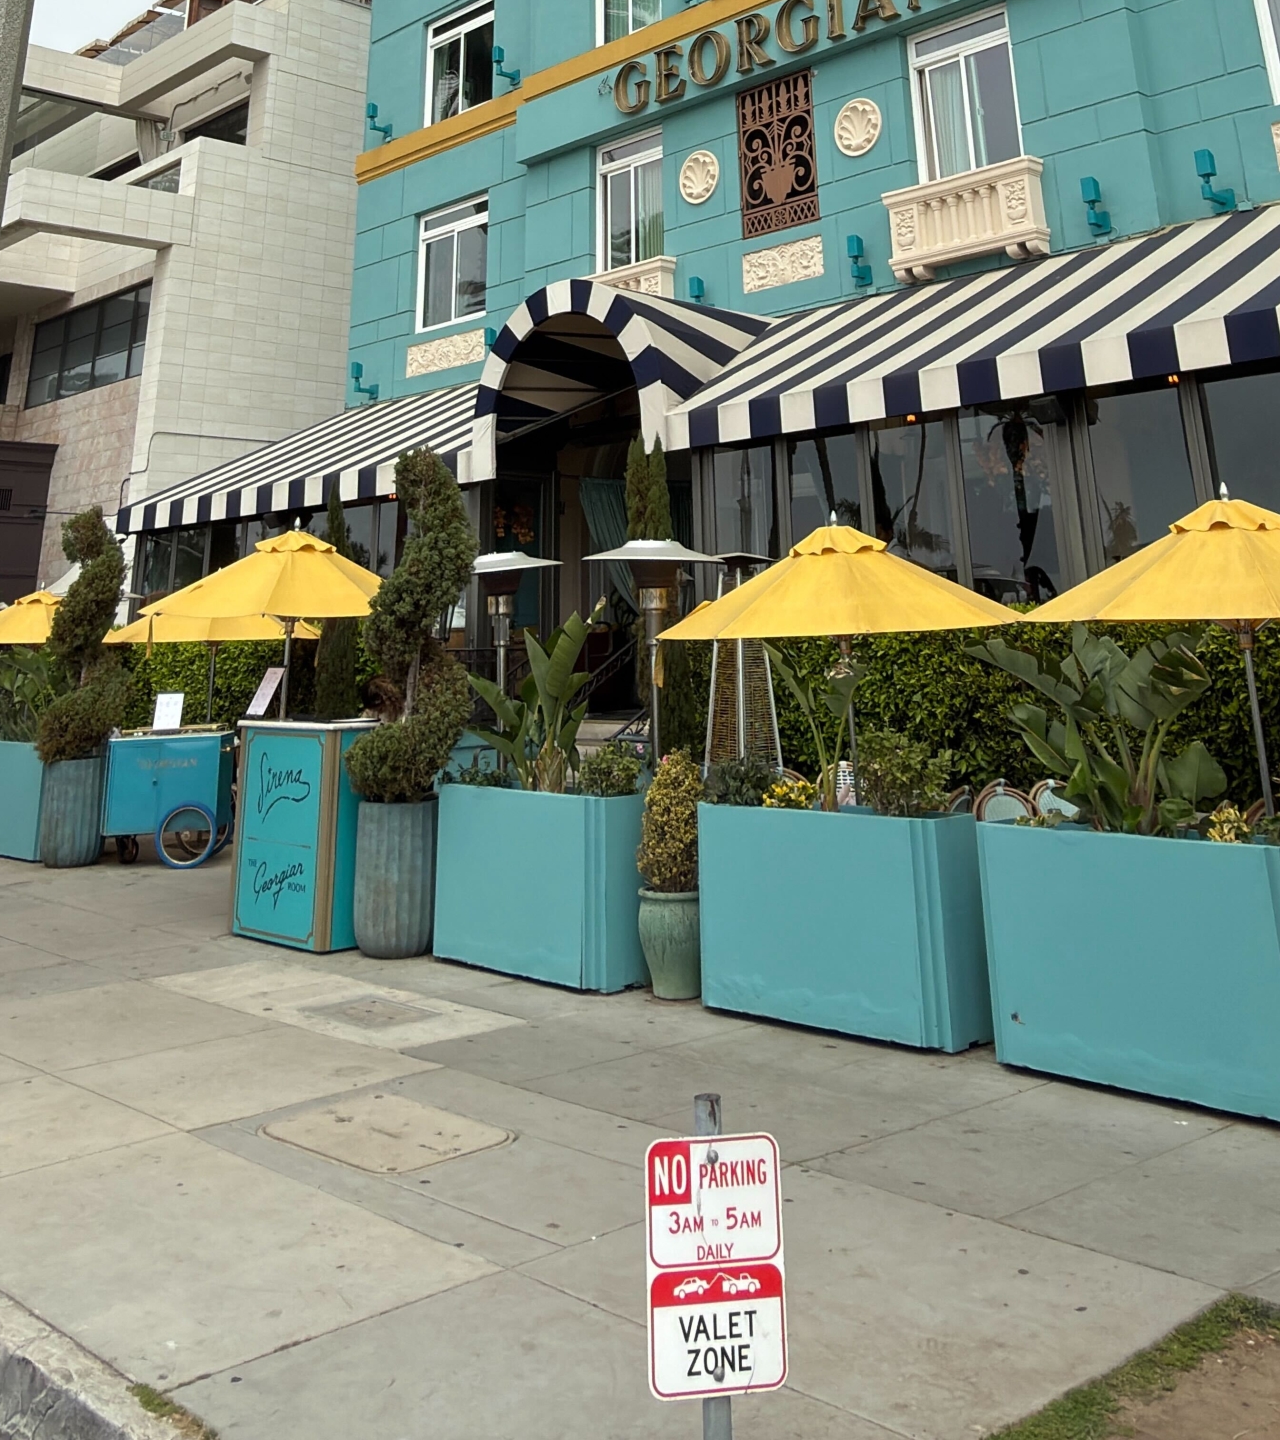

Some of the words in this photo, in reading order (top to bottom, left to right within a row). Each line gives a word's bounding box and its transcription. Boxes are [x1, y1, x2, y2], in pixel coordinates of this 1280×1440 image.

[257, 751, 310, 823] Sirena
[248, 858, 258, 868] THE
[253, 861, 305, 910] Georgian
[287, 882, 306, 894] ROOM
[654, 1154, 688, 1196] NO
[699, 1158, 768, 1190] PARKING
[668, 1211, 704, 1235] 3AM
[725, 1206, 762, 1230] 5AM
[696, 1242, 734, 1261] DAILY
[678, 1310, 758, 1343] VALET
[687, 1344, 752, 1378] ZONE
